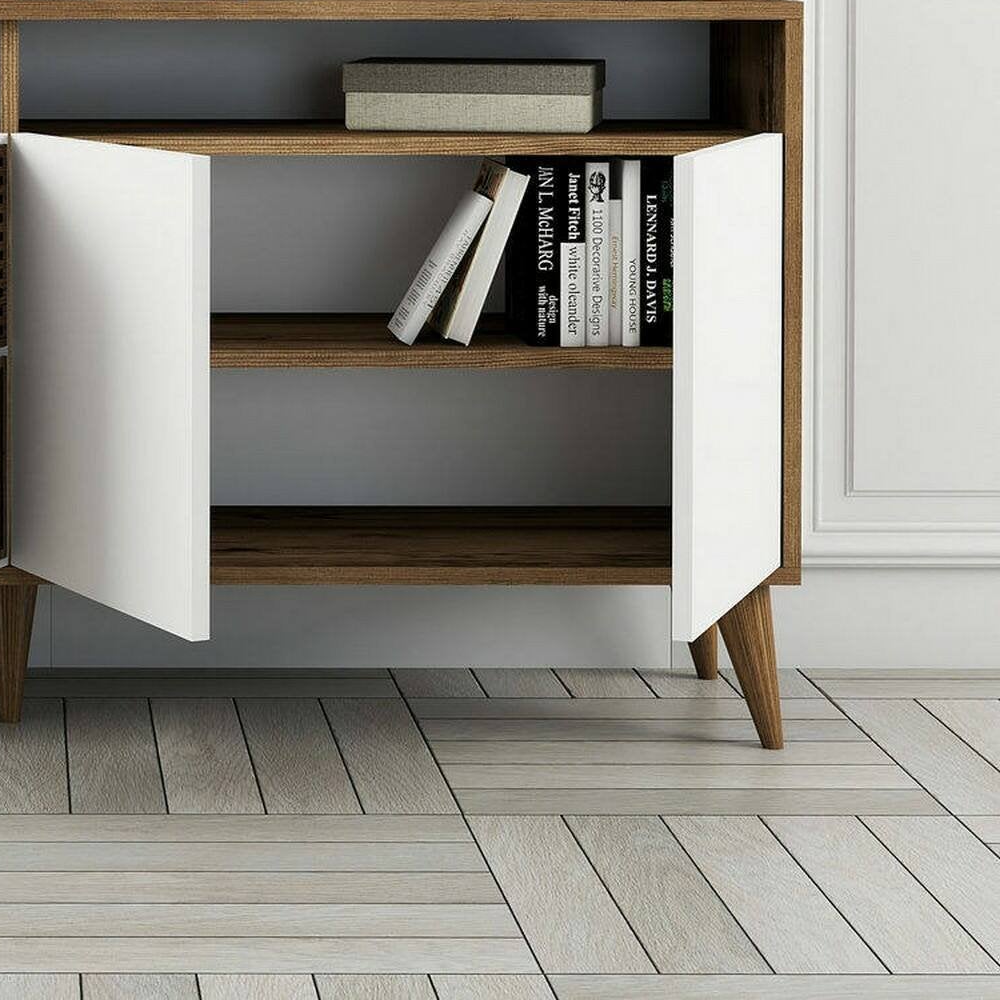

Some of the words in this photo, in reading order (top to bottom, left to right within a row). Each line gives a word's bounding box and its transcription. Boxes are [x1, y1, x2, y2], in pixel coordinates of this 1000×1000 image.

[539, 192, 553, 203] L.
[568, 173, 580, 204] Janet
[568, 208, 580, 239] Fitch
[592, 209, 603, 234] 1100
[646, 195, 657, 263] LENNARD
[538, 208, 553, 270] McHARG
[568, 247, 580, 280] white
[629, 259, 637, 296] YOUNG
[646, 265, 657, 276] J.
[538, 285, 548, 305] with
[548, 295, 558, 323] design
[568, 283, 580, 336] oleander
[646, 280, 656, 323] DAVIS
[538, 307, 549, 337] nature
[589, 296, 603, 336] Designs
[629, 298, 637, 334] HOUSE
